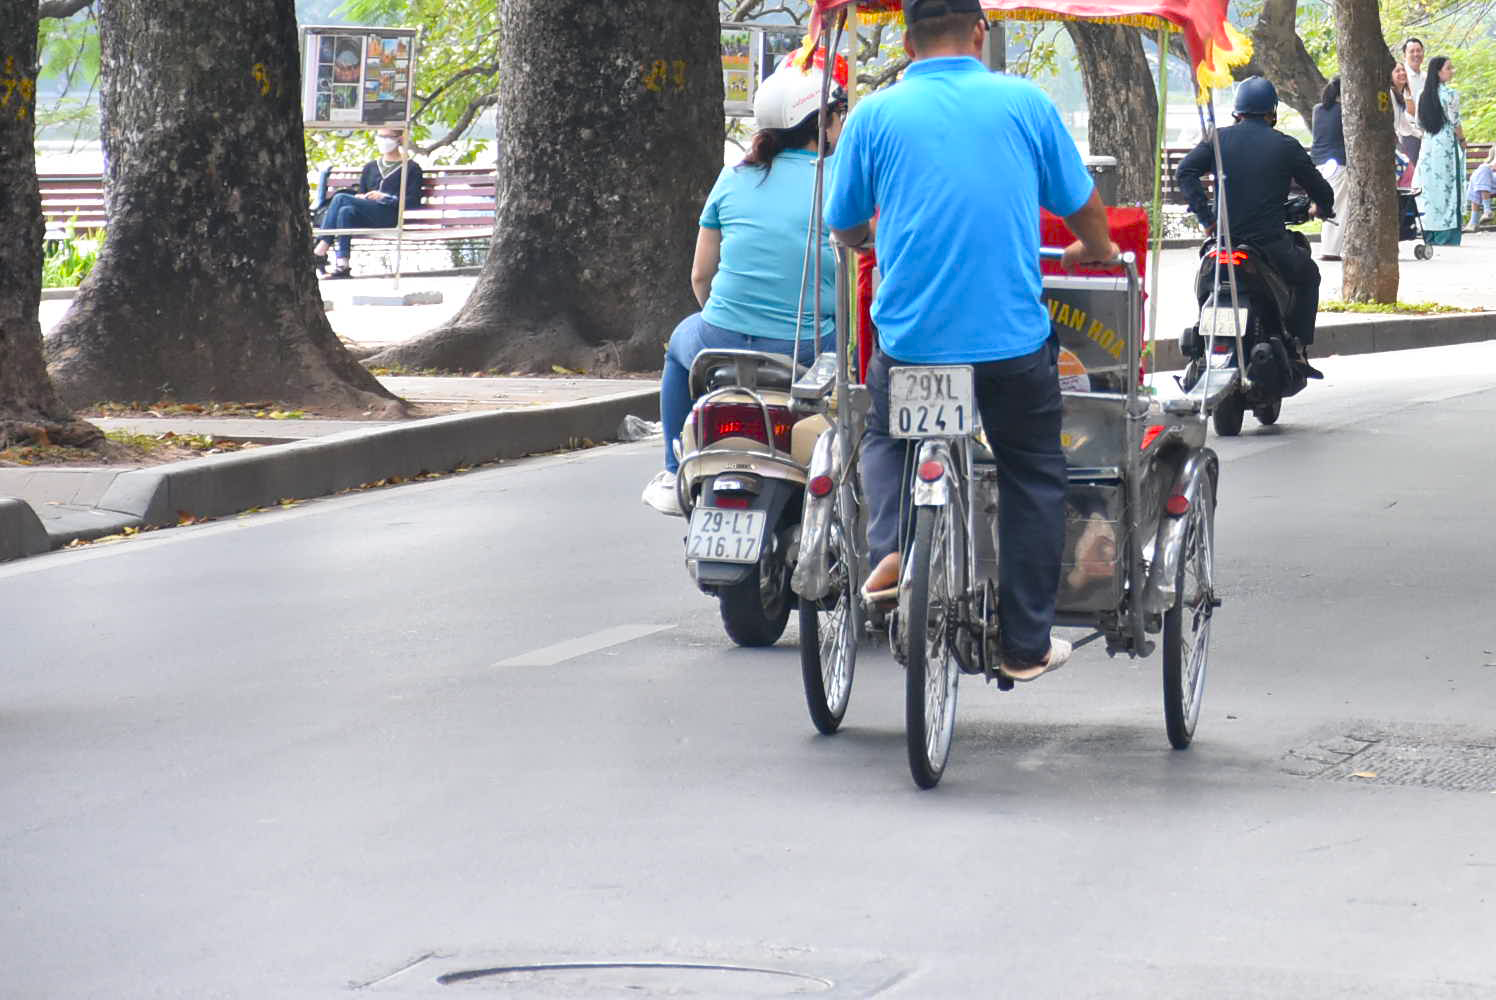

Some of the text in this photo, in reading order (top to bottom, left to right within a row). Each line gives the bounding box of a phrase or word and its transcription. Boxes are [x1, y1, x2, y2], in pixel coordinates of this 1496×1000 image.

[905, 374, 959, 401] 29XL
[899, 404, 964, 432] 0241
[702, 512, 754, 534] 29-L1
[691, 536, 756, 559] 216.17
